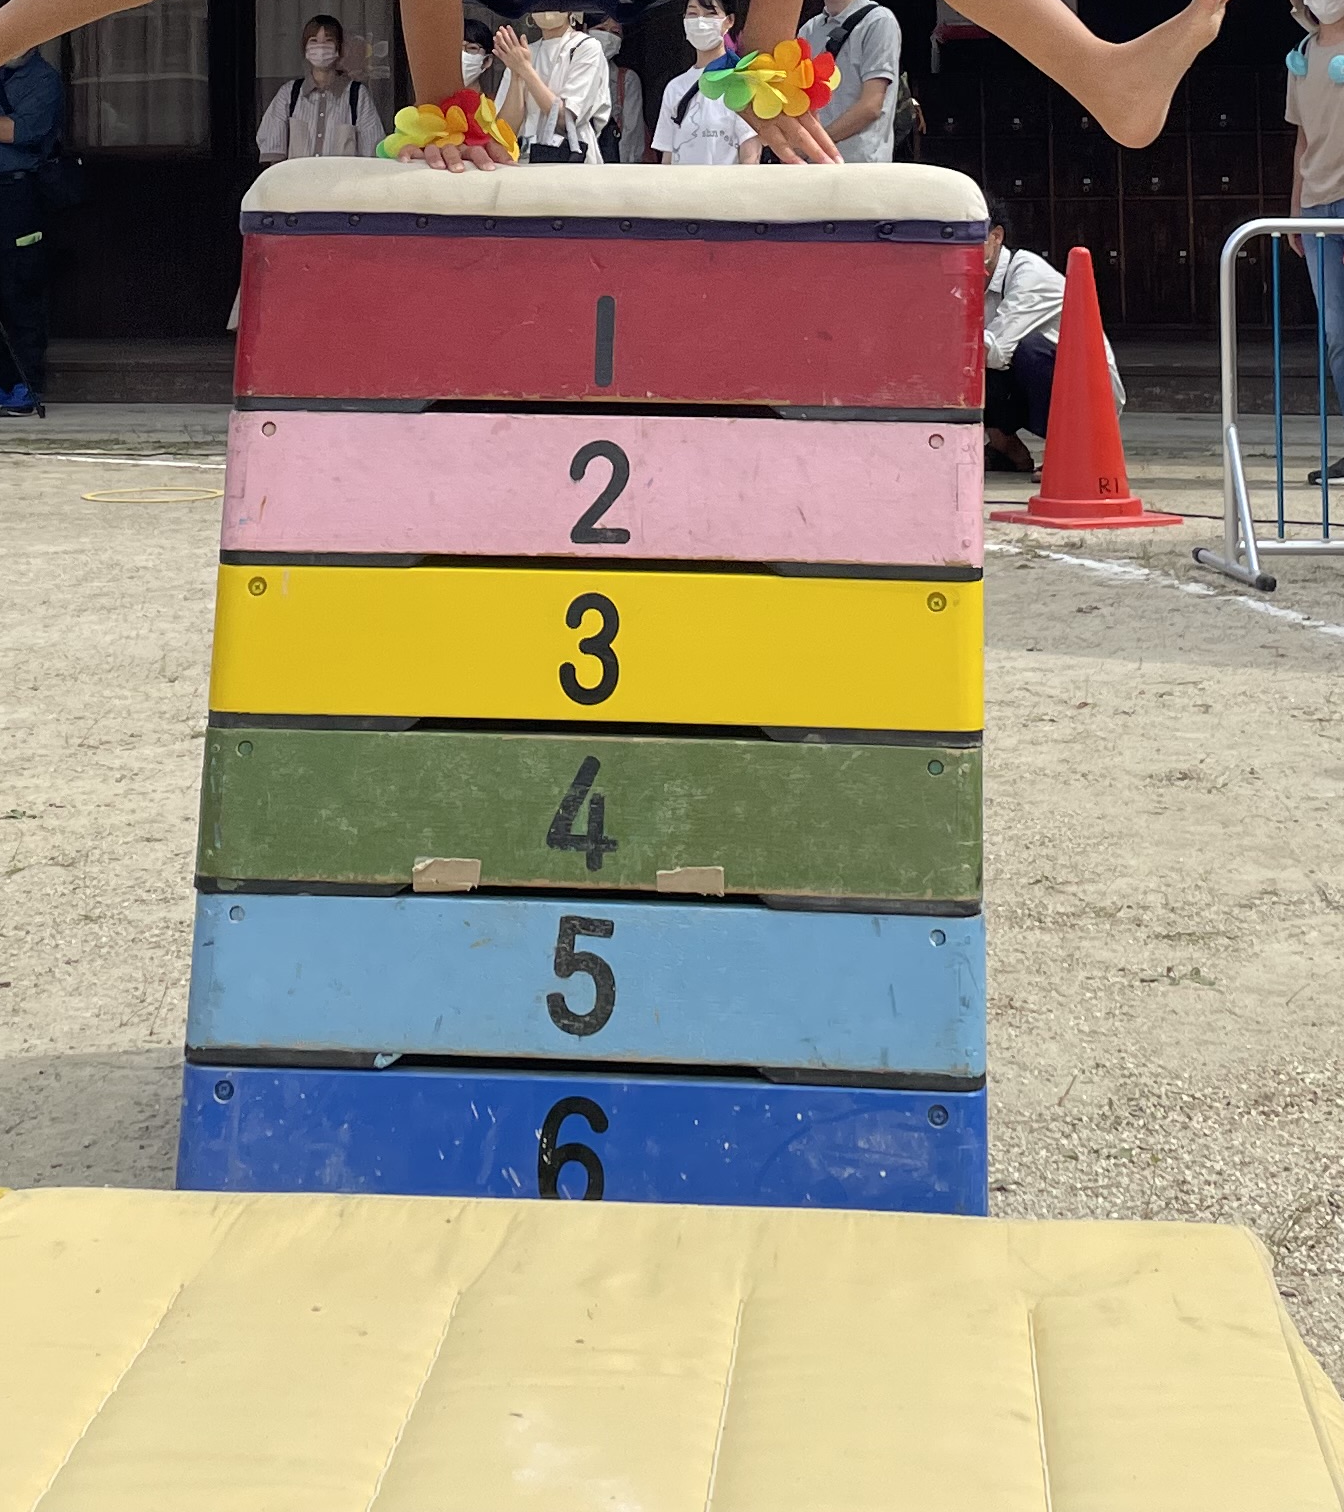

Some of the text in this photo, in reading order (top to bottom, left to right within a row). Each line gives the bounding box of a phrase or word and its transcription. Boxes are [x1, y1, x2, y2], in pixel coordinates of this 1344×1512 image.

[596, 295, 615, 387] 1
[568, 439, 631, 545] 2
[558, 591, 621, 706] 3
[545, 754, 619, 872] 4
[545, 914, 616, 1037] 5
[537, 1095, 609, 1201] 6
